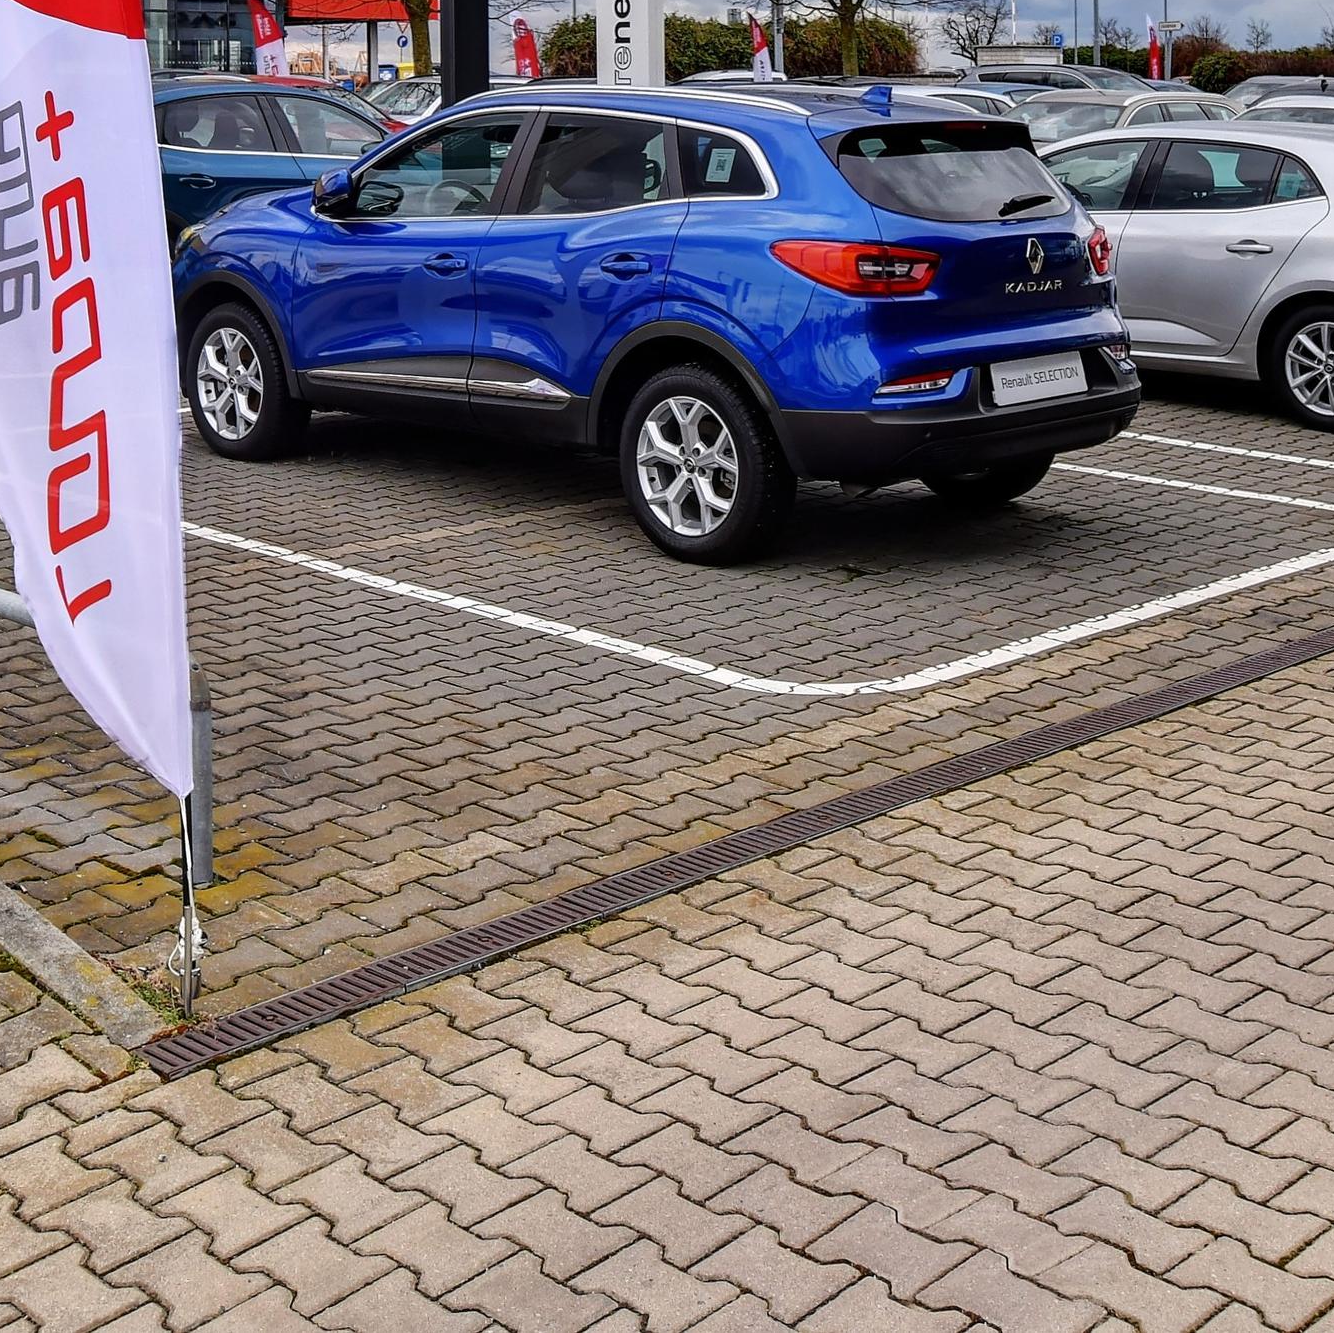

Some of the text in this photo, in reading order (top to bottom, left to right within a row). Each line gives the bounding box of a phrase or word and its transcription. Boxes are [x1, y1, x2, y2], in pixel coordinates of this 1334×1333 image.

[1005, 279, 1063, 294] KADJAR
[1000, 366, 1079, 389] Renault SELECTION
